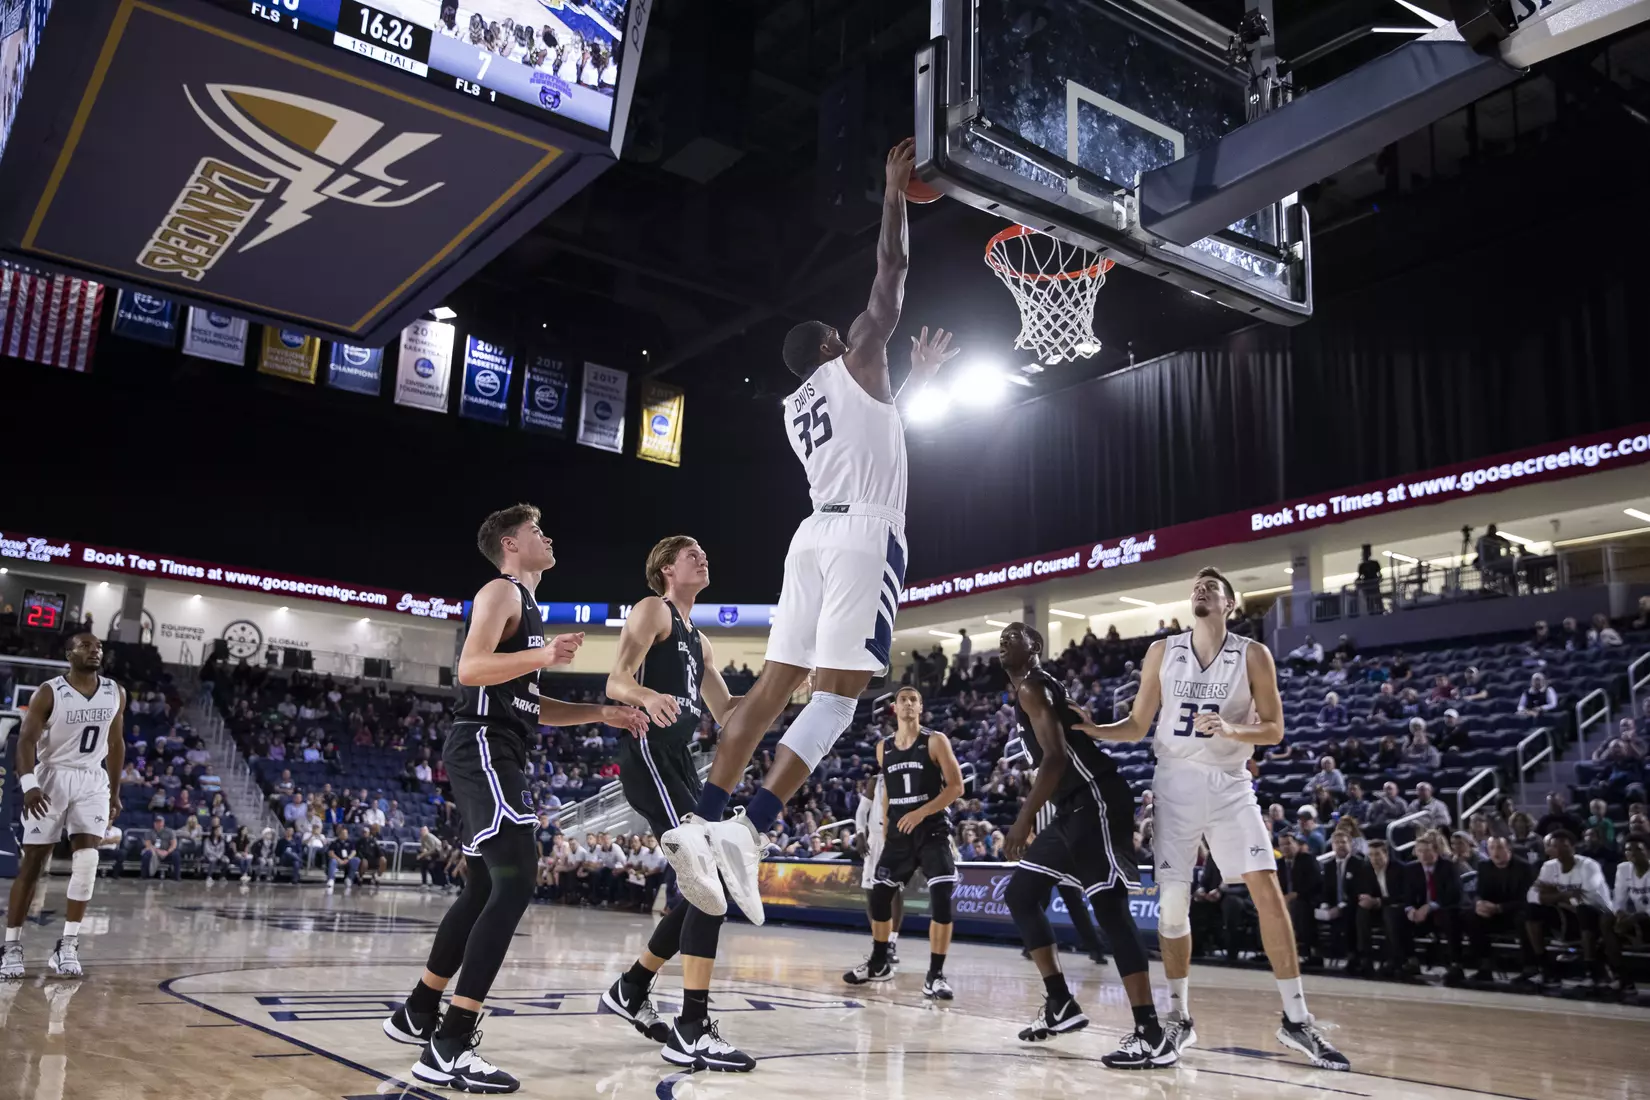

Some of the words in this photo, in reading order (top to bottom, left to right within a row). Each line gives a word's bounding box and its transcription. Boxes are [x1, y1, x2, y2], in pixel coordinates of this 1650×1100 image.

[251, 2, 280, 22] FLS
[292, 17, 298, 29] 1
[360, 8, 413, 50] 16:26
[351, 40, 374, 56] 1ST
[384, 52, 415, 70] HALF
[477, 51, 492, 80] 7
[455, 78, 480, 96] FLS
[490, 90, 496, 102] 1
[136, 157, 280, 281] LANCERS
[470, 350, 507, 364] WOMEN'S
[476, 340, 504, 356] 2017
[329, 363, 379, 379] CHAMPIONS
[536, 356, 562, 371] 2017
[592, 371, 618, 385] 2017
[463, 393, 507, 410] CHAMPIONS
[793, 382, 815, 413] DAVIS
[793, 396, 832, 460] 35
[1251, 507, 1294, 531] Book
[1294, 502, 1327, 521] Tee
[1329, 491, 1383, 515] Times
[1387, 483, 1406, 502] at
[1407, 434, 1650, 499] www.goosecreekgc.co
[1, 548, 26, 558] GOLF
[26, 552, 50, 562] CLUB
[27, 537, 71, 557] Creek
[1087, 543, 1122, 569] Goose
[1119, 534, 1156, 555] Creek
[83, 548, 125, 567] Book
[127, 554, 156, 571] Tee
[159, 559, 205, 578] Times
[207, 568, 222, 580] at
[224, 570, 387, 604] www.goosecreekgc.com
[910, 581, 953, 601] Empire's
[952, 576, 973, 593] Top
[975, 567, 1006, 587] Rated
[1008, 562, 1032, 581] Golf
[1034, 551, 1080, 575] Course!
[396, 593, 430, 611] Goose
[27, 605, 56, 627] 23
[573, 604, 590, 623] 10
[175, 632, 201, 641] SERVE
[1173, 680, 1228, 699] LANCERS
[66, 708, 114, 725] LANCERS
[79, 725, 100, 753] 0
[887, 761, 924, 773] CENTRAL
[902, 773, 912, 794] 1
[889, 794, 929, 805] ARKANSAS
[956, 900, 984, 913] GOLF
